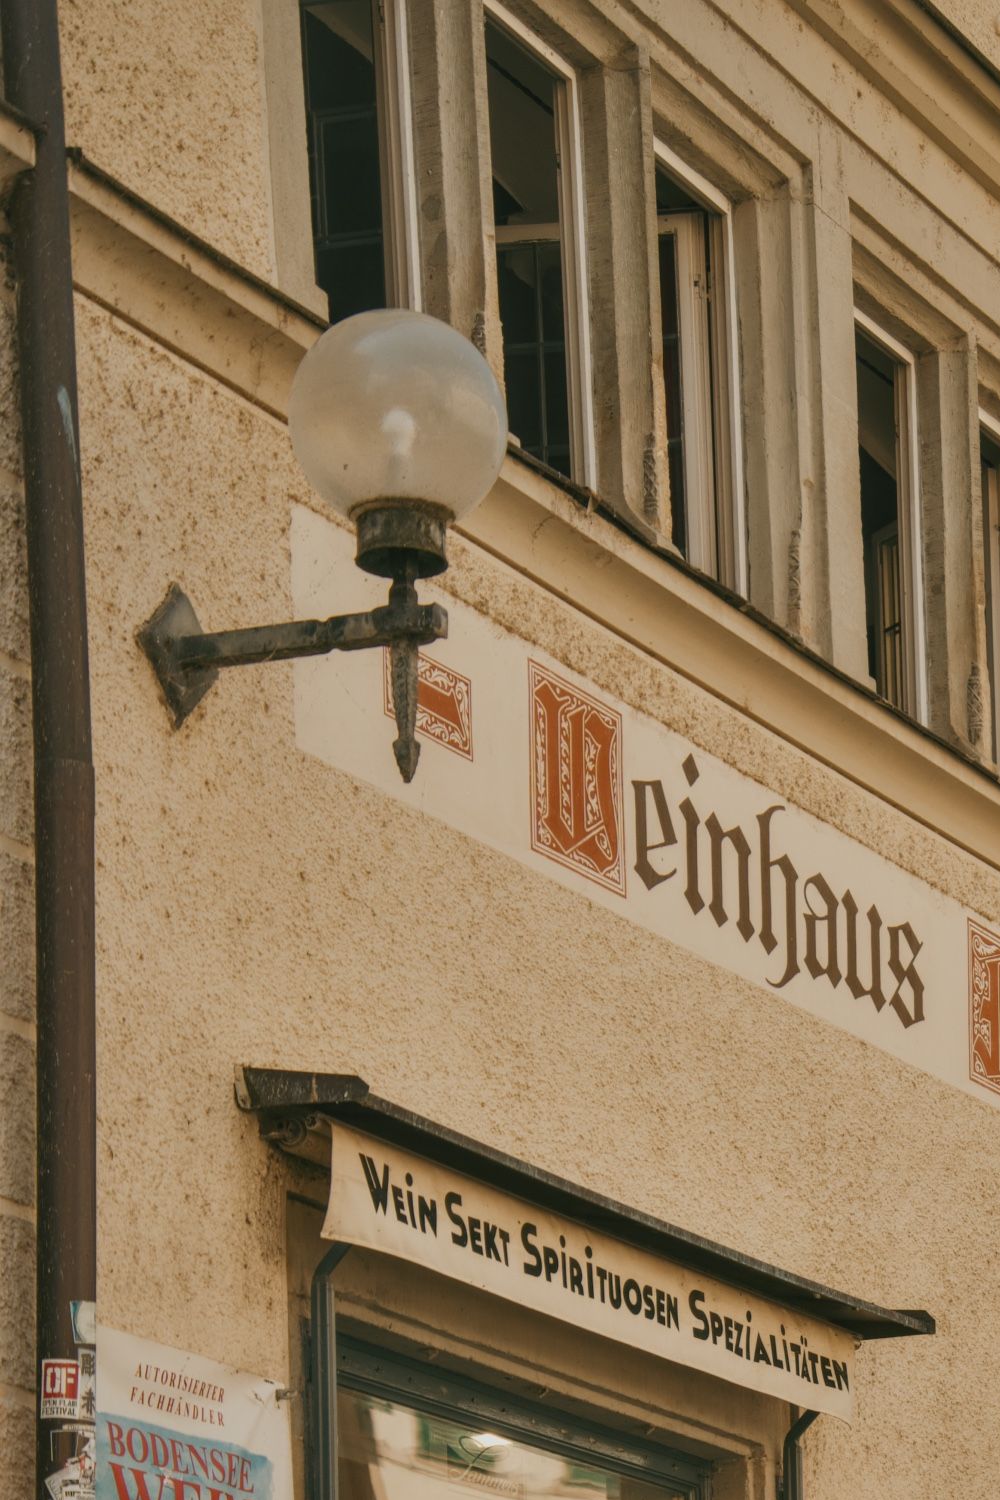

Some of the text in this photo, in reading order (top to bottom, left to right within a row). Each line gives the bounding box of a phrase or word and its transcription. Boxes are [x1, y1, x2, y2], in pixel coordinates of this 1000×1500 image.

[134, 1363, 225, 1404] AUTORISIERTER
[42, 1408, 77, 1416] FESTIVAL
[130, 1386, 225, 1427] FACHHÄNDLER
[105, 1419, 255, 1493] BODENSEE
